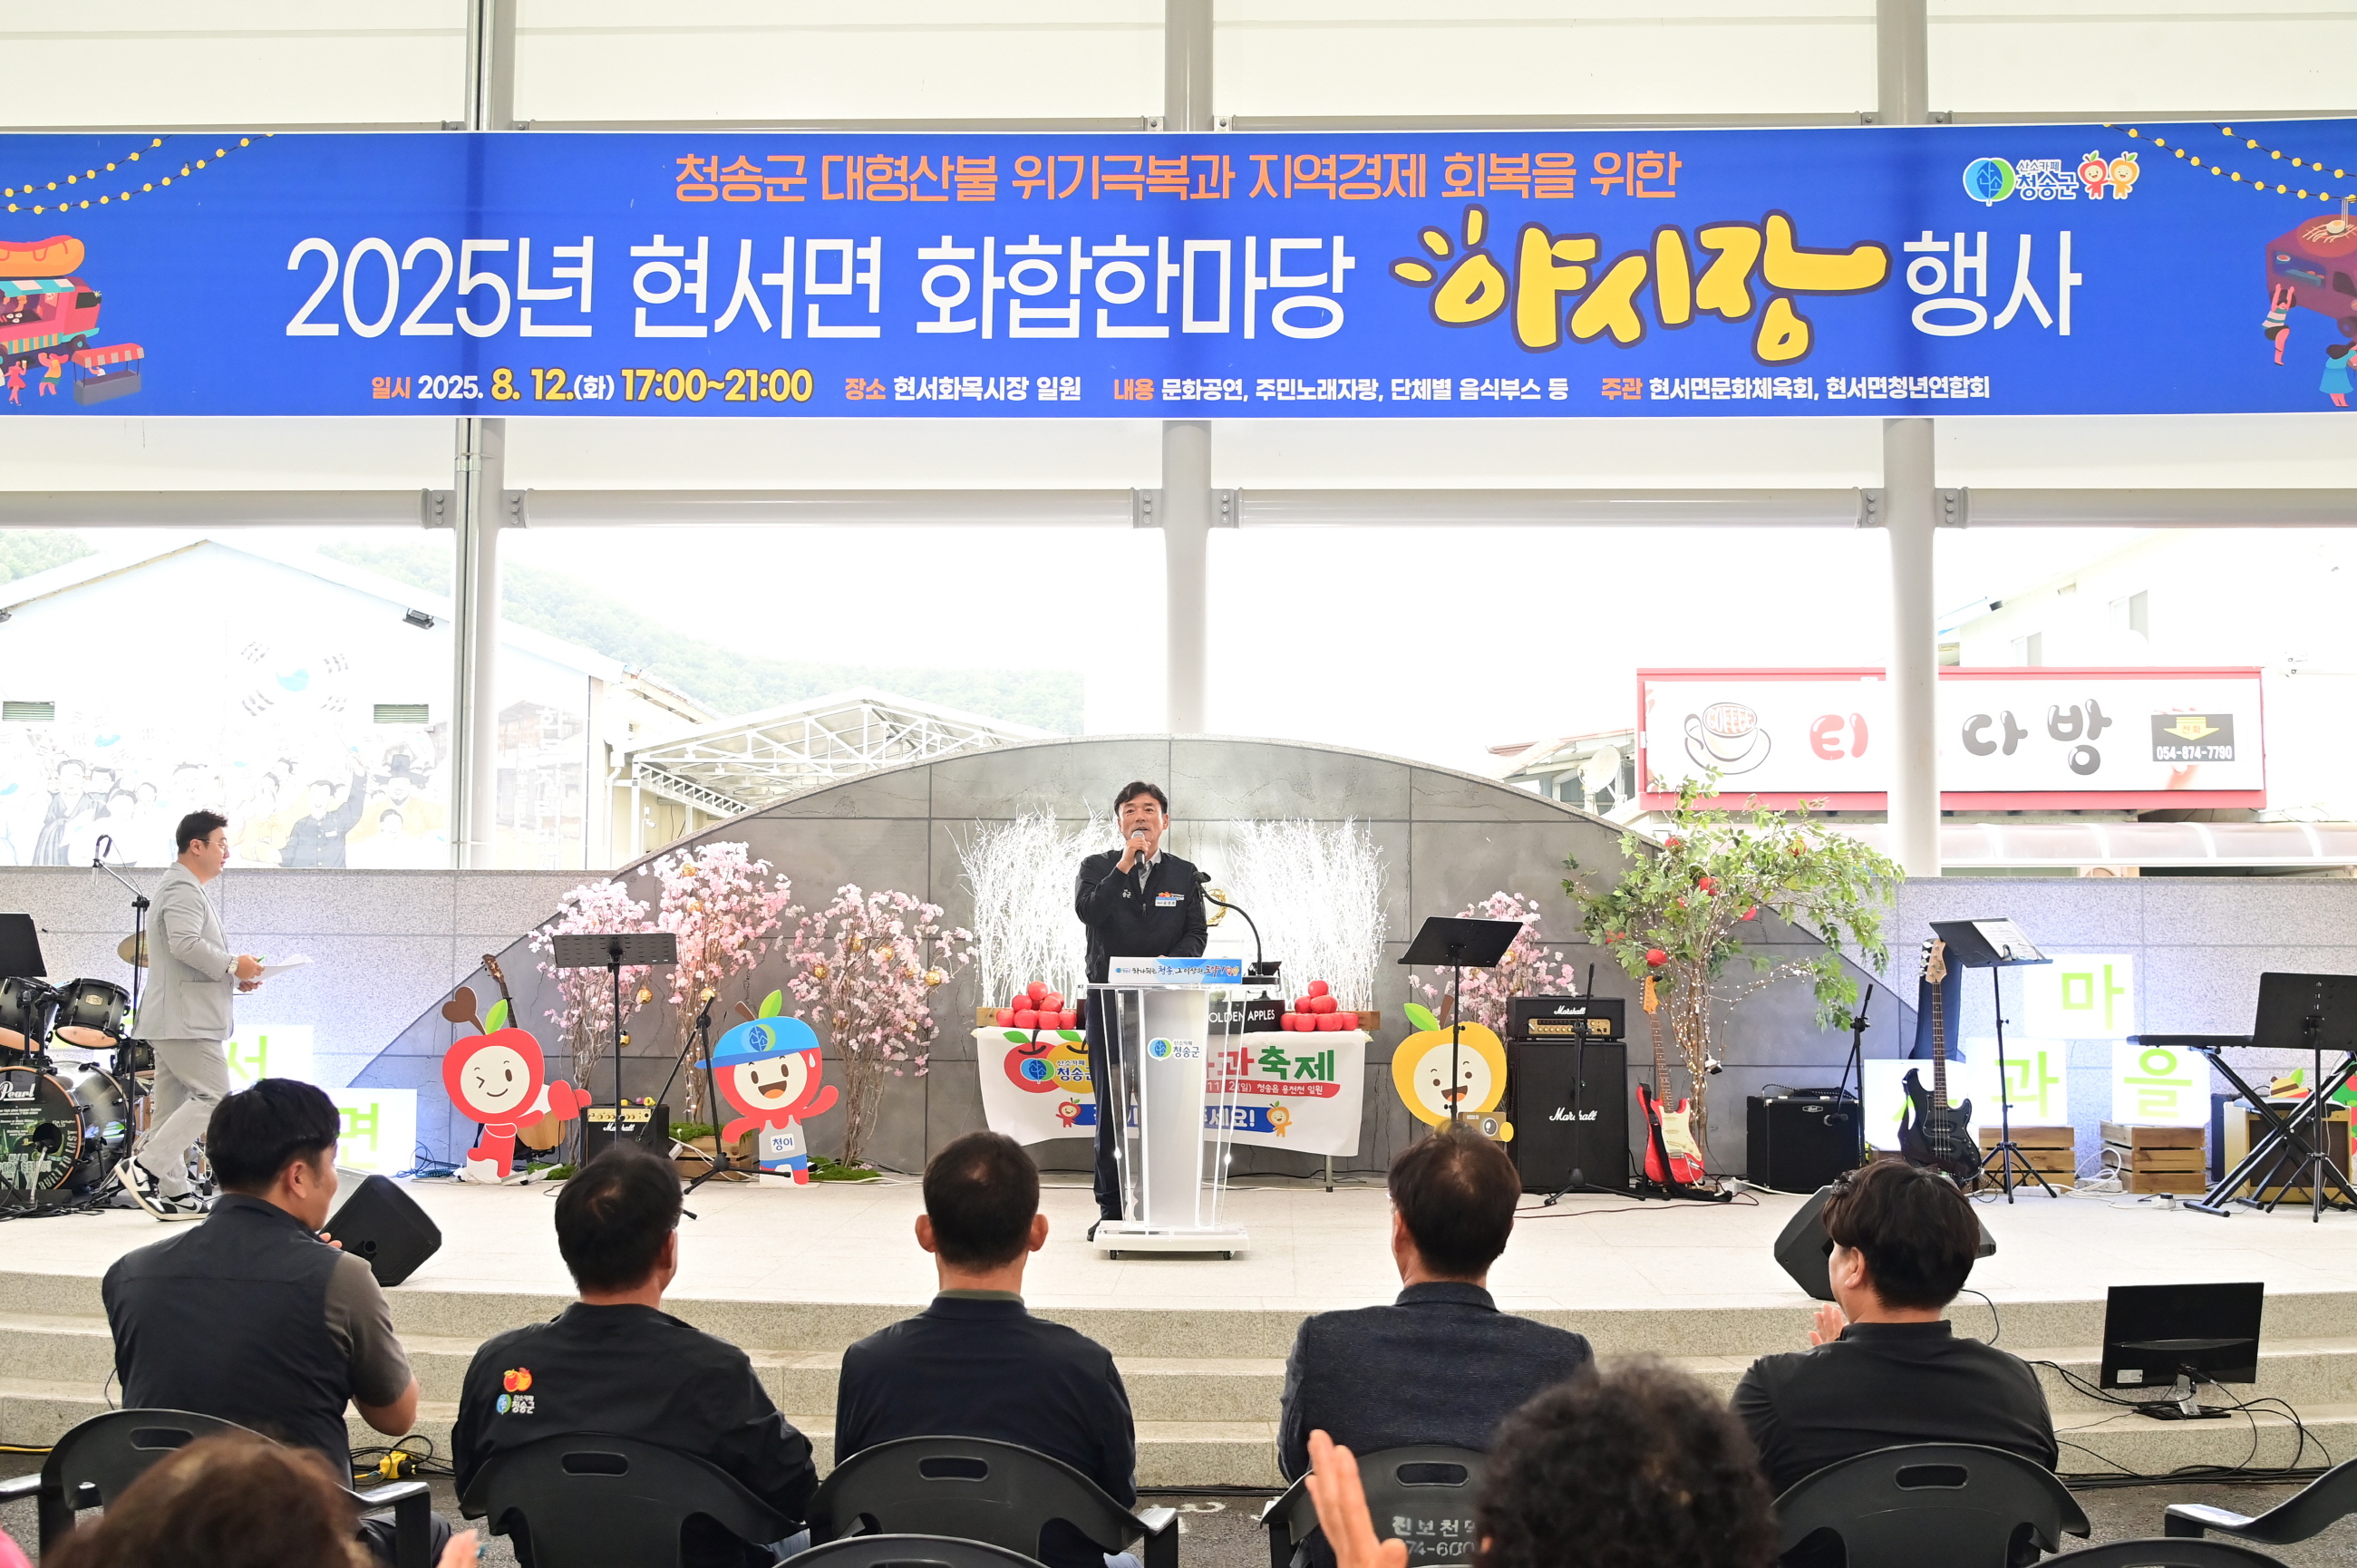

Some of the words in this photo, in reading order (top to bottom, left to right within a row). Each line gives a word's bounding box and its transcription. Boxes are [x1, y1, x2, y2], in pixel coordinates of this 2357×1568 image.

[675, 152, 808, 202] 청송군
[821, 153, 999, 202] 대형산불
[1012, 154, 1237, 201] 위기극복과
[1248, 152, 1428, 200] 지역경제
[1440, 151, 1577, 199] 회복을
[1590, 150, 1683, 198] 위한
[2017, 160, 2061, 172] 산소카페
[2017, 172, 2078, 198] 청송군
[286, 236, 595, 339] 2025년
[629, 234, 882, 340] 현서면
[916, 234, 1356, 341] 화합한마당
[1414, 211, 1890, 363] 야시장
[1903, 229, 2082, 337] 행사
[371, 376, 412, 400] 일시
[417, 374, 484, 400] 2025.
[490, 367, 521, 402] 8.
[530, 368, 616, 402] 12.(화)
[621, 367, 814, 402] 17:00~21:00
[844, 377, 887, 401] 장소
[893, 375, 1030, 402] 현서화목시장
[1036, 375, 1082, 402] 일원
[1113, 376, 1155, 402] 내용
[1161, 377, 1250, 402] 문화공연,
[1255, 377, 1385, 402] 주민노래자랑,
[1391, 376, 1452, 402] 단체별
[1459, 376, 1542, 402] 음식부스
[1547, 376, 1569, 402] 등
[1601, 376, 1644, 401] 주관
[1649, 376, 1820, 402] 현서면문화체육회,
[1826, 375, 1991, 401] 현서면청년연합회
[1809, 712, 1868, 760] 티
[1962, 698, 2113, 776] 다방
[2182, 725, 2201, 734] 전화
[2156, 745, 2233, 760] 054-874-7790
[2061, 963, 2125, 1031] 마
[1208, 1011, 1245, 1023] OLDEN
[1247, 1009, 1275, 1021] APPLES
[1553, 1005, 1586, 1015] Marshall
[1173, 1046, 1200, 1059] 청송군
[0, 1081, 35, 1100] Pearl
[1306, 1085, 1324, 1096] 일원
[1991, 1050, 2060, 1118] 과
[2123, 1048, 2193, 1118] 을
[1548, 1107, 1598, 1121] Marhall
[602, 1122, 635, 1132] Mahall
[771, 1137, 794, 1152] 청이
[38, 1167, 64, 1190] BUILT
[1405, 1542, 1476, 1557] 74-600
